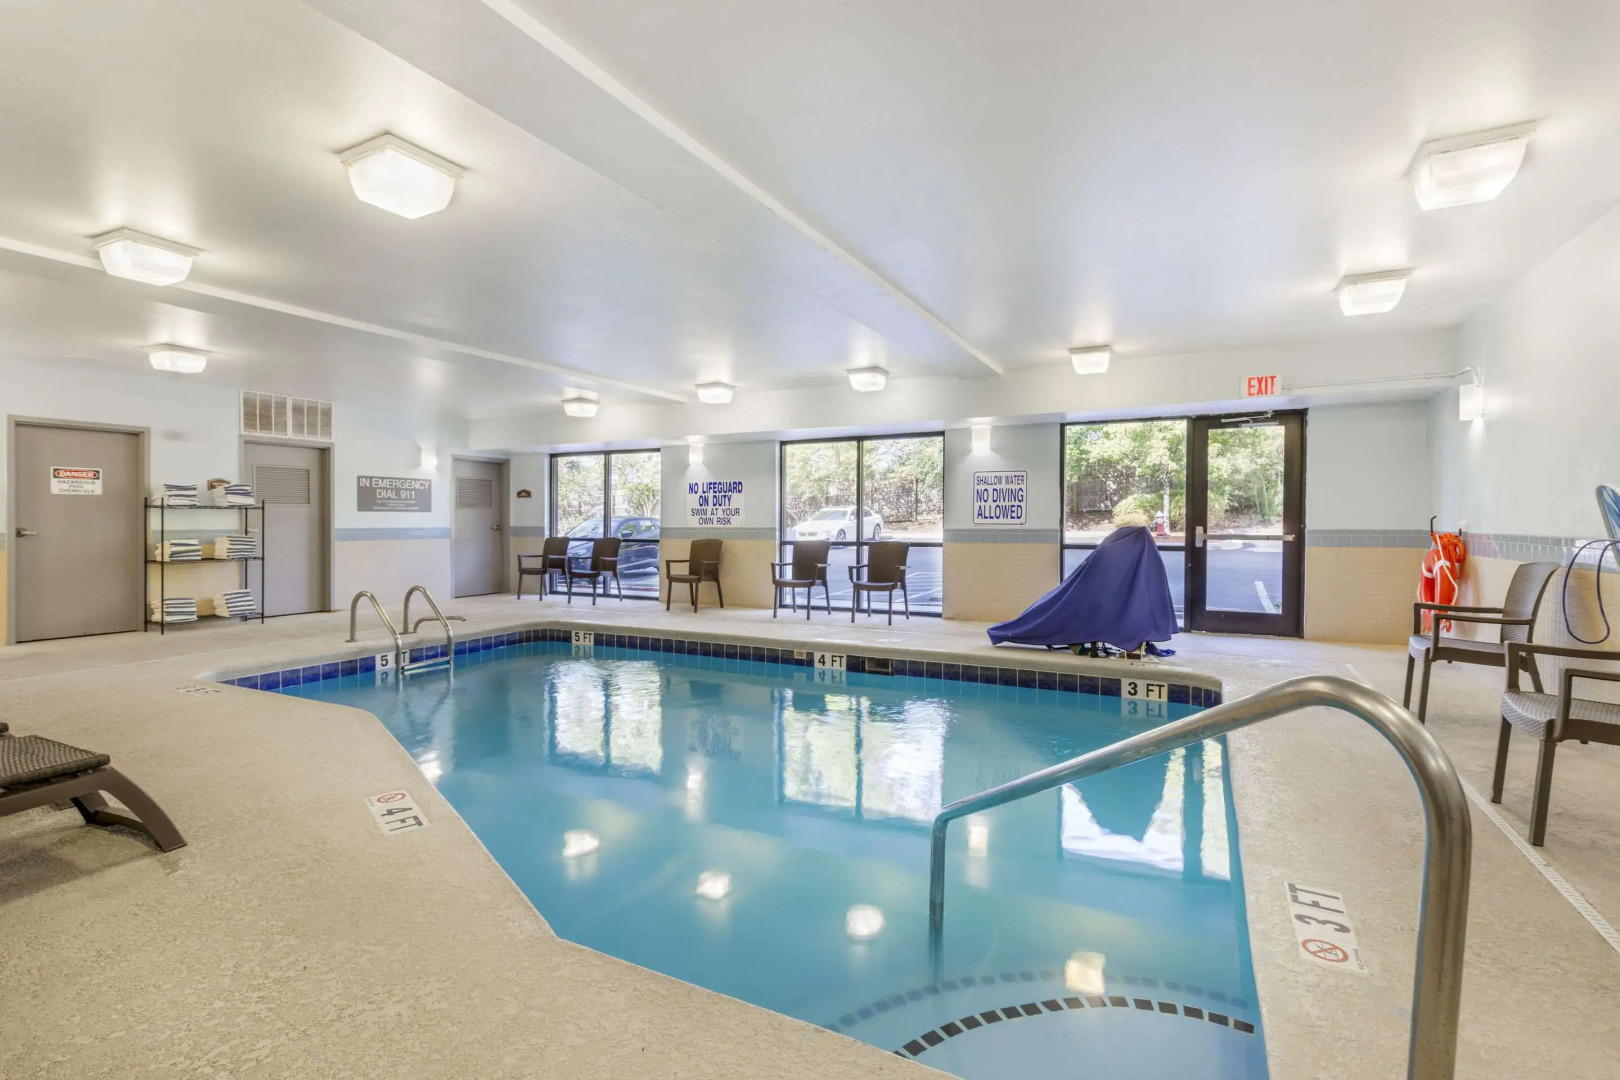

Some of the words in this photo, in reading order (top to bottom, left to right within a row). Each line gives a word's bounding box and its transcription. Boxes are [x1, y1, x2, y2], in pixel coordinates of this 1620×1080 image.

[1247, 375, 1277, 396] EXIT
[61, 470, 91, 478] DANGER
[976, 475, 1003, 486] SHALLOW
[1005, 475, 1025, 485] WATER
[360, 477, 370, 487] IN
[372, 477, 430, 490] EMERGENCY
[688, 482, 699, 494] NO
[702, 481, 743, 494] LIFEGUARD
[376, 489, 398, 499] DIAL
[400, 490, 415, 499] 911
[698, 494, 709, 507] ON
[712, 494, 732, 507] DUTY
[976, 488, 989, 503] NO
[992, 487, 1024, 503] DIVING
[691, 508, 708, 517] SWIM
[710, 508, 719, 517] AT
[721, 507, 741, 517] YOUR
[976, 504, 1023, 520] ALLOWED
[698, 517, 714, 526] OWN
[716, 517, 732, 526] RISK
[574, 631, 580, 643] 5
[583, 632, 593, 644] FT
[380, 654, 389, 667] 5
[818, 654, 826, 667] 4
[831, 654, 844, 668] FT
[1127, 681, 1138, 697] 3
[1146, 683, 1165, 699] FT
[380, 807, 414, 817] 4
[384, 815, 424, 832] FT
[1287, 882, 1345, 914] FT
[1294, 913, 1351, 934] 3
